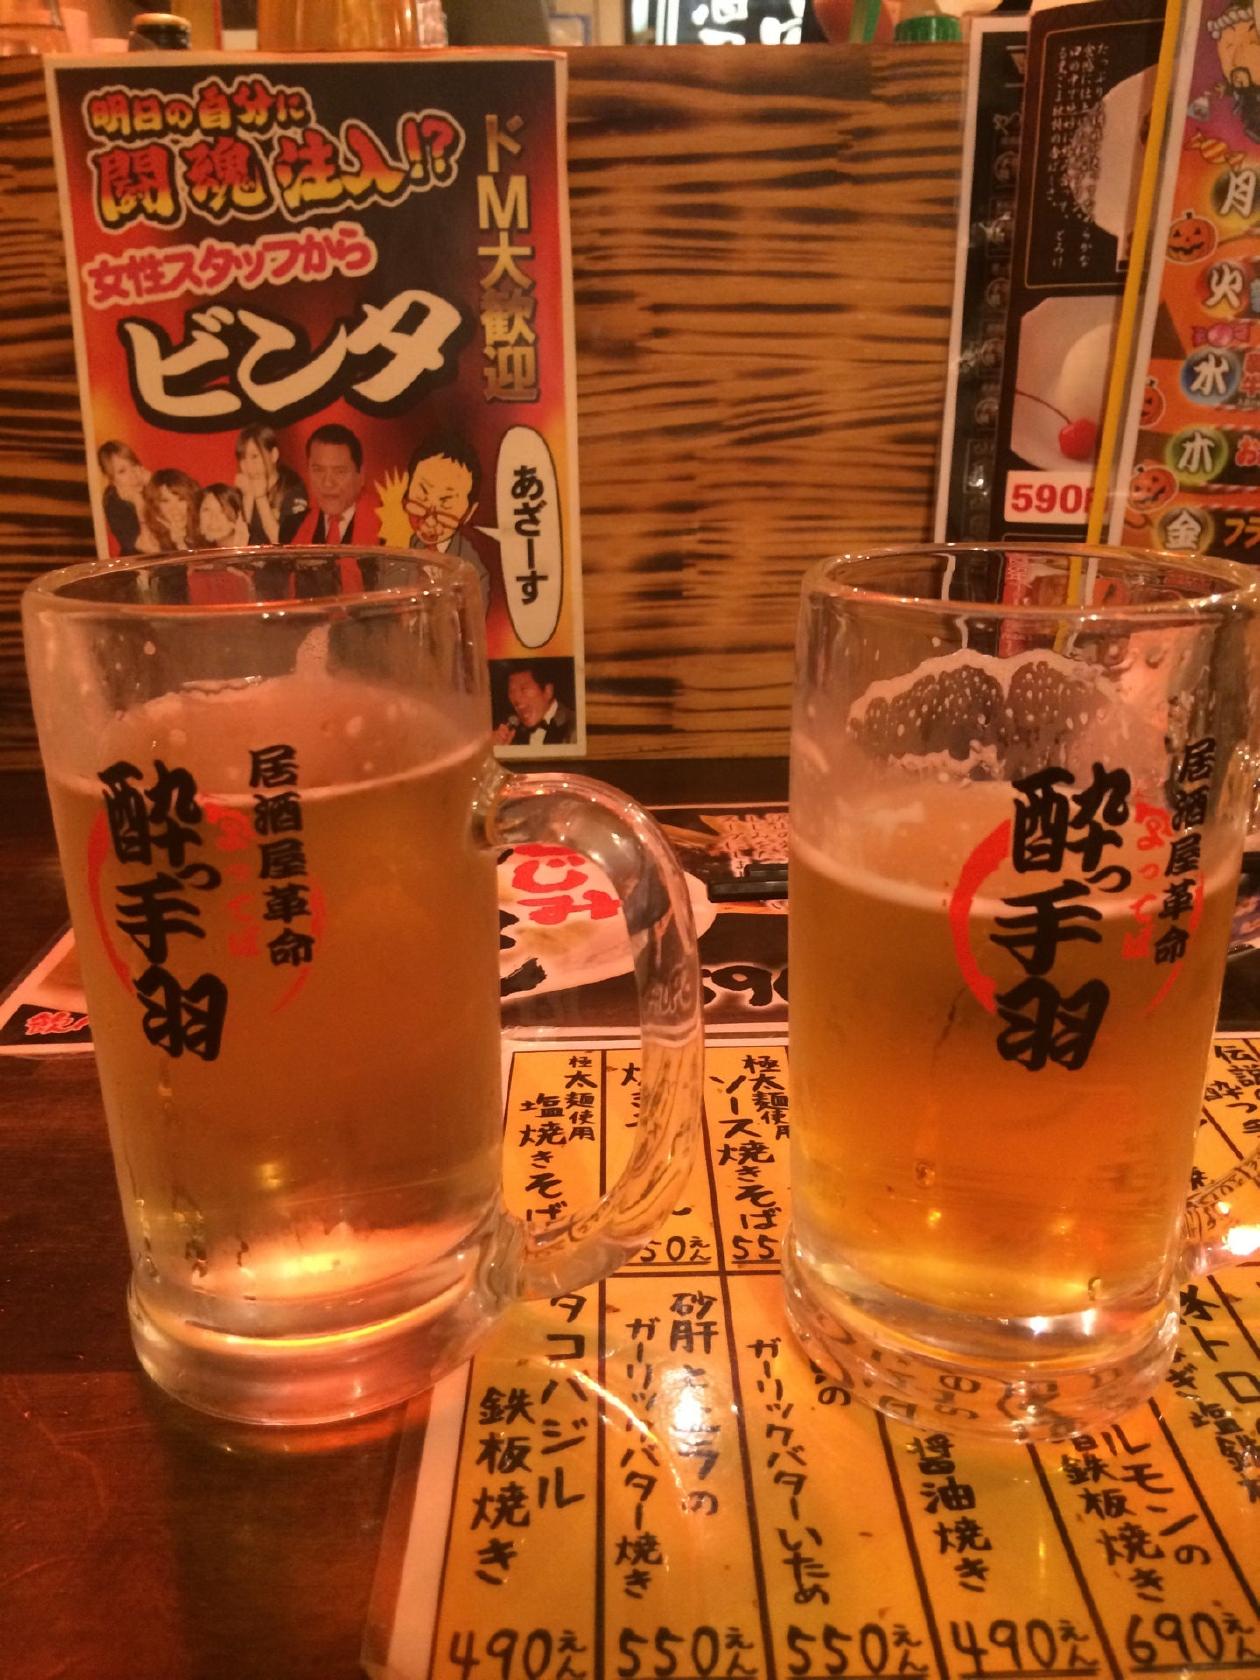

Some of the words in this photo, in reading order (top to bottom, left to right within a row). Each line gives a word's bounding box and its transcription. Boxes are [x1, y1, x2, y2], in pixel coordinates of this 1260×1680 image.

[88, 77, 308, 137] 明日の自分に
[1219, 169, 1257, 218] 月
[88, 228, 374, 303] 女性スタッフから
[1205, 262, 1244, 308] 火
[120, 289, 464, 418] ビンタ
[1189, 353, 1230, 397] 水
[1010, 483, 1096, 514] 590
[1177, 431, 1216, 474] 木
[510, 464, 549, 606] あざーす
[1165, 510, 1203, 550] 金
[97, 759, 229, 1062] 酔っ手羽
[248, 744, 316, 967] 居酒屋革命
[1153, 737, 1217, 966] 居酒屋革命
[988, 761, 1132, 1073] 酔っ手羽
[563, 1054, 599, 1142] 極太麺使用
[708, 1073, 784, 1231] ソース焼きそば
[470, 1386, 536, 1587] 鉄板焼き
[745, 1336, 831, 1606] ガーリックバターいため
[904, 1433, 993, 1593] 醤油焼き
